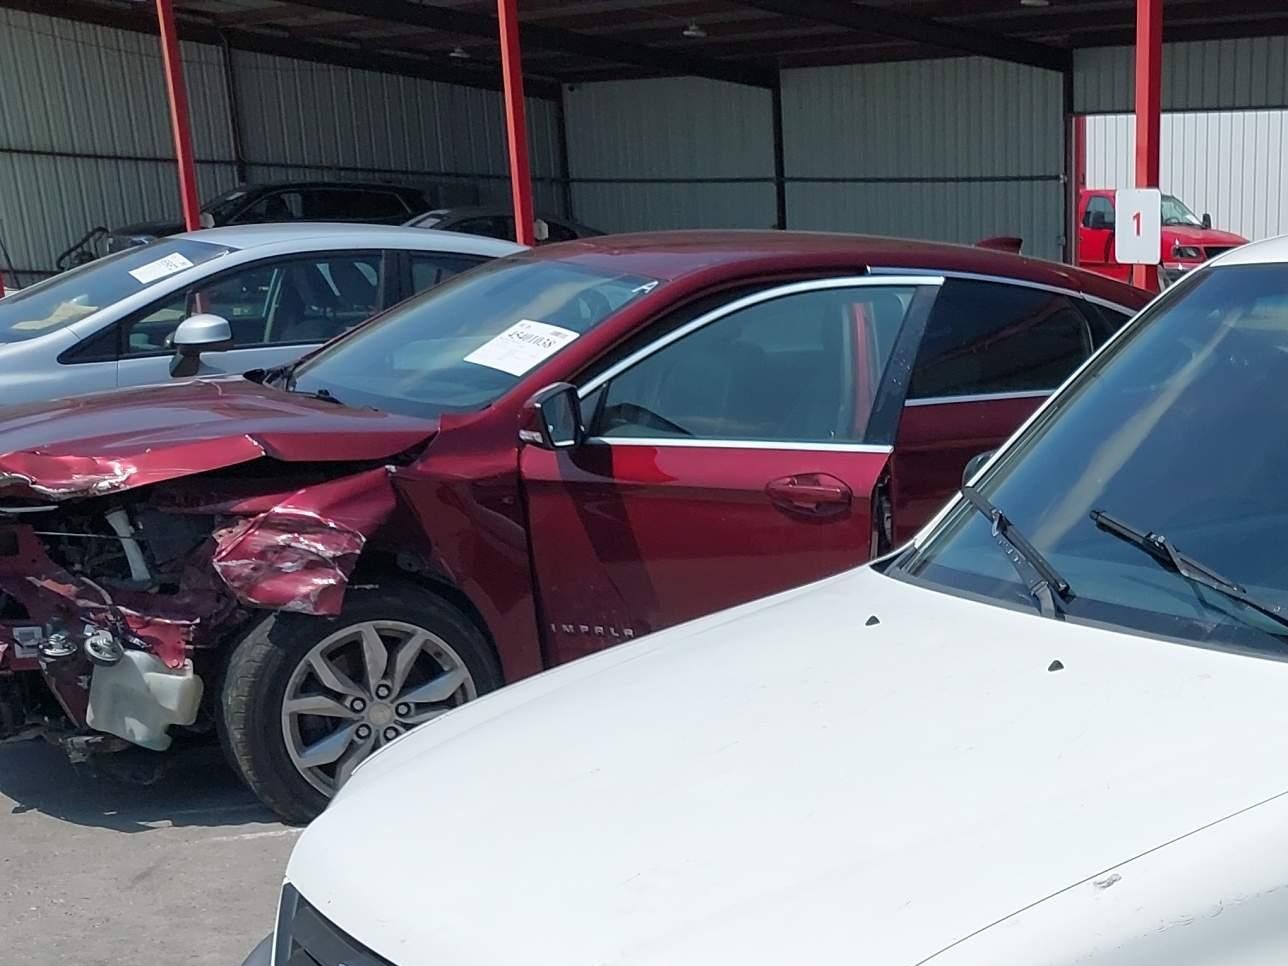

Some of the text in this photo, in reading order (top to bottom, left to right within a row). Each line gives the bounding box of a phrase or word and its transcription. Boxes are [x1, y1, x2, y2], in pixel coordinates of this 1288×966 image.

[1132, 212, 1142, 236] 1
[632, 280, 658, 294] A
[550, 623, 634, 637] IMPALA
